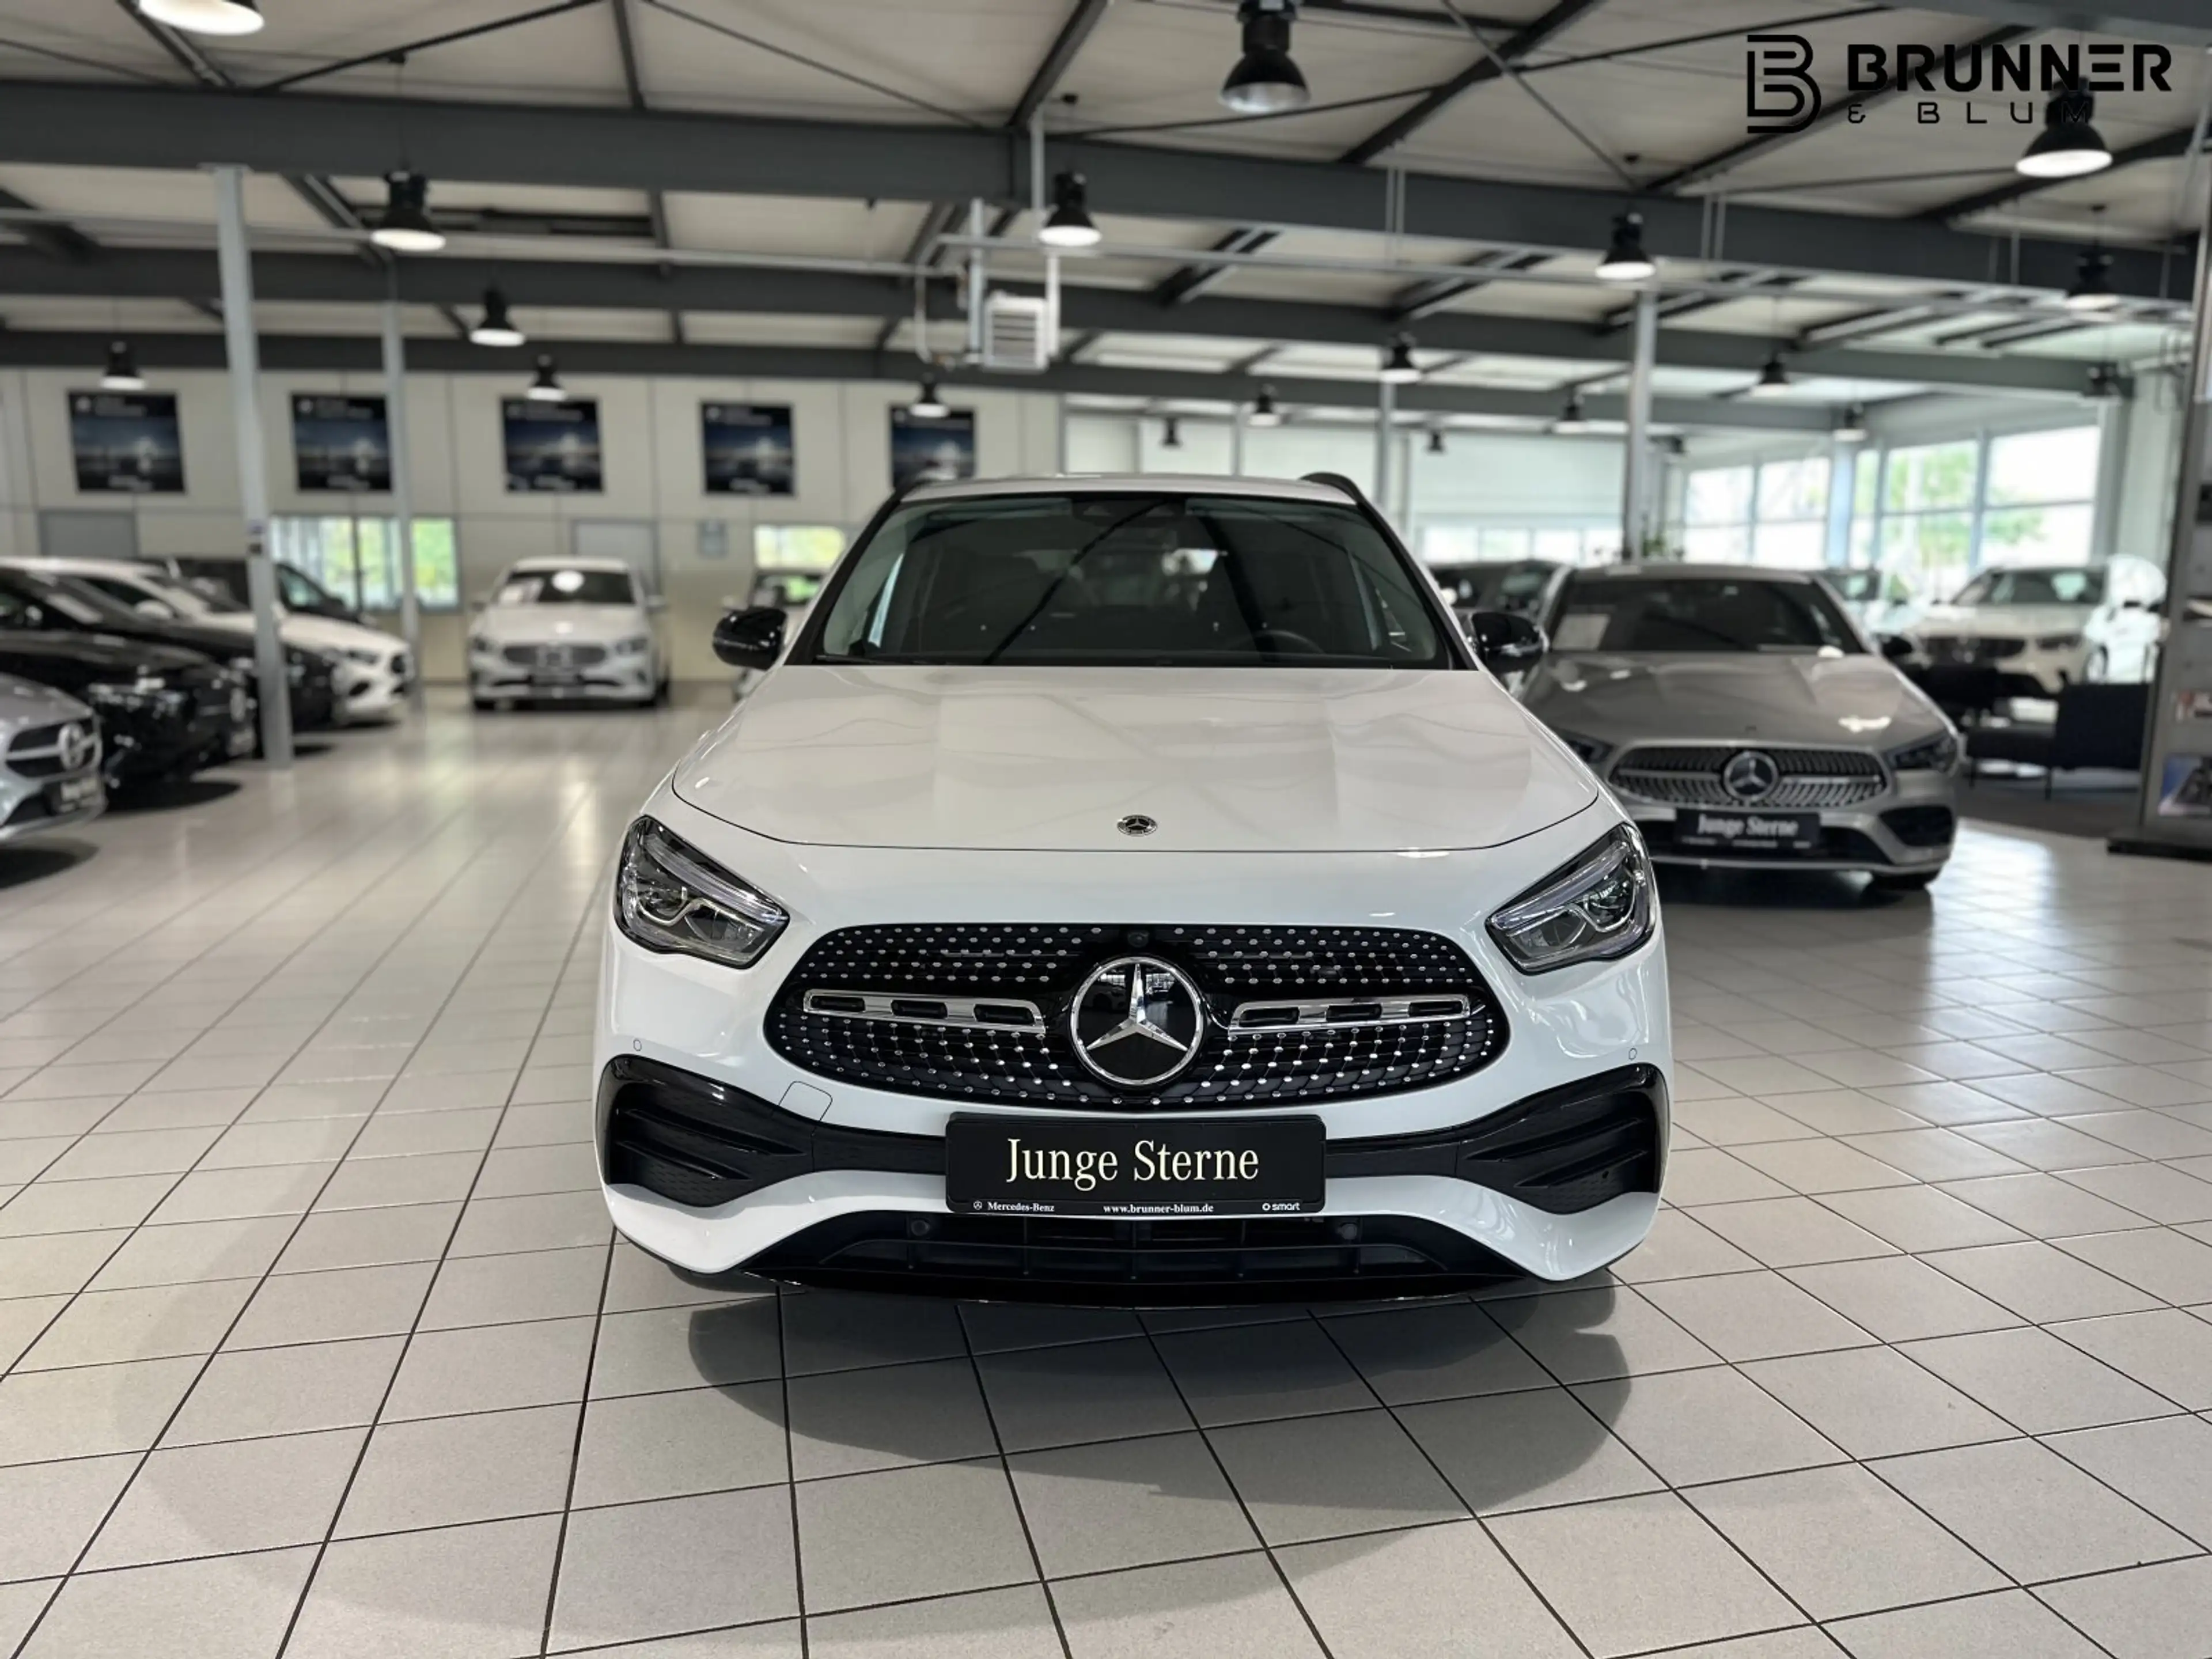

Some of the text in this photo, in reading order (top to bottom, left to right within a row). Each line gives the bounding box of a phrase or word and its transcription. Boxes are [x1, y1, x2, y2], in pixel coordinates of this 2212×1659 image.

[1006, 1138, 1259, 1191] Junge Sterne
[987, 1201, 1055, 1212] Mercedes-Benz
[1103, 1203, 1214, 1214] www.brunner-blum.de
[1272, 1202, 1301, 1211] smart
